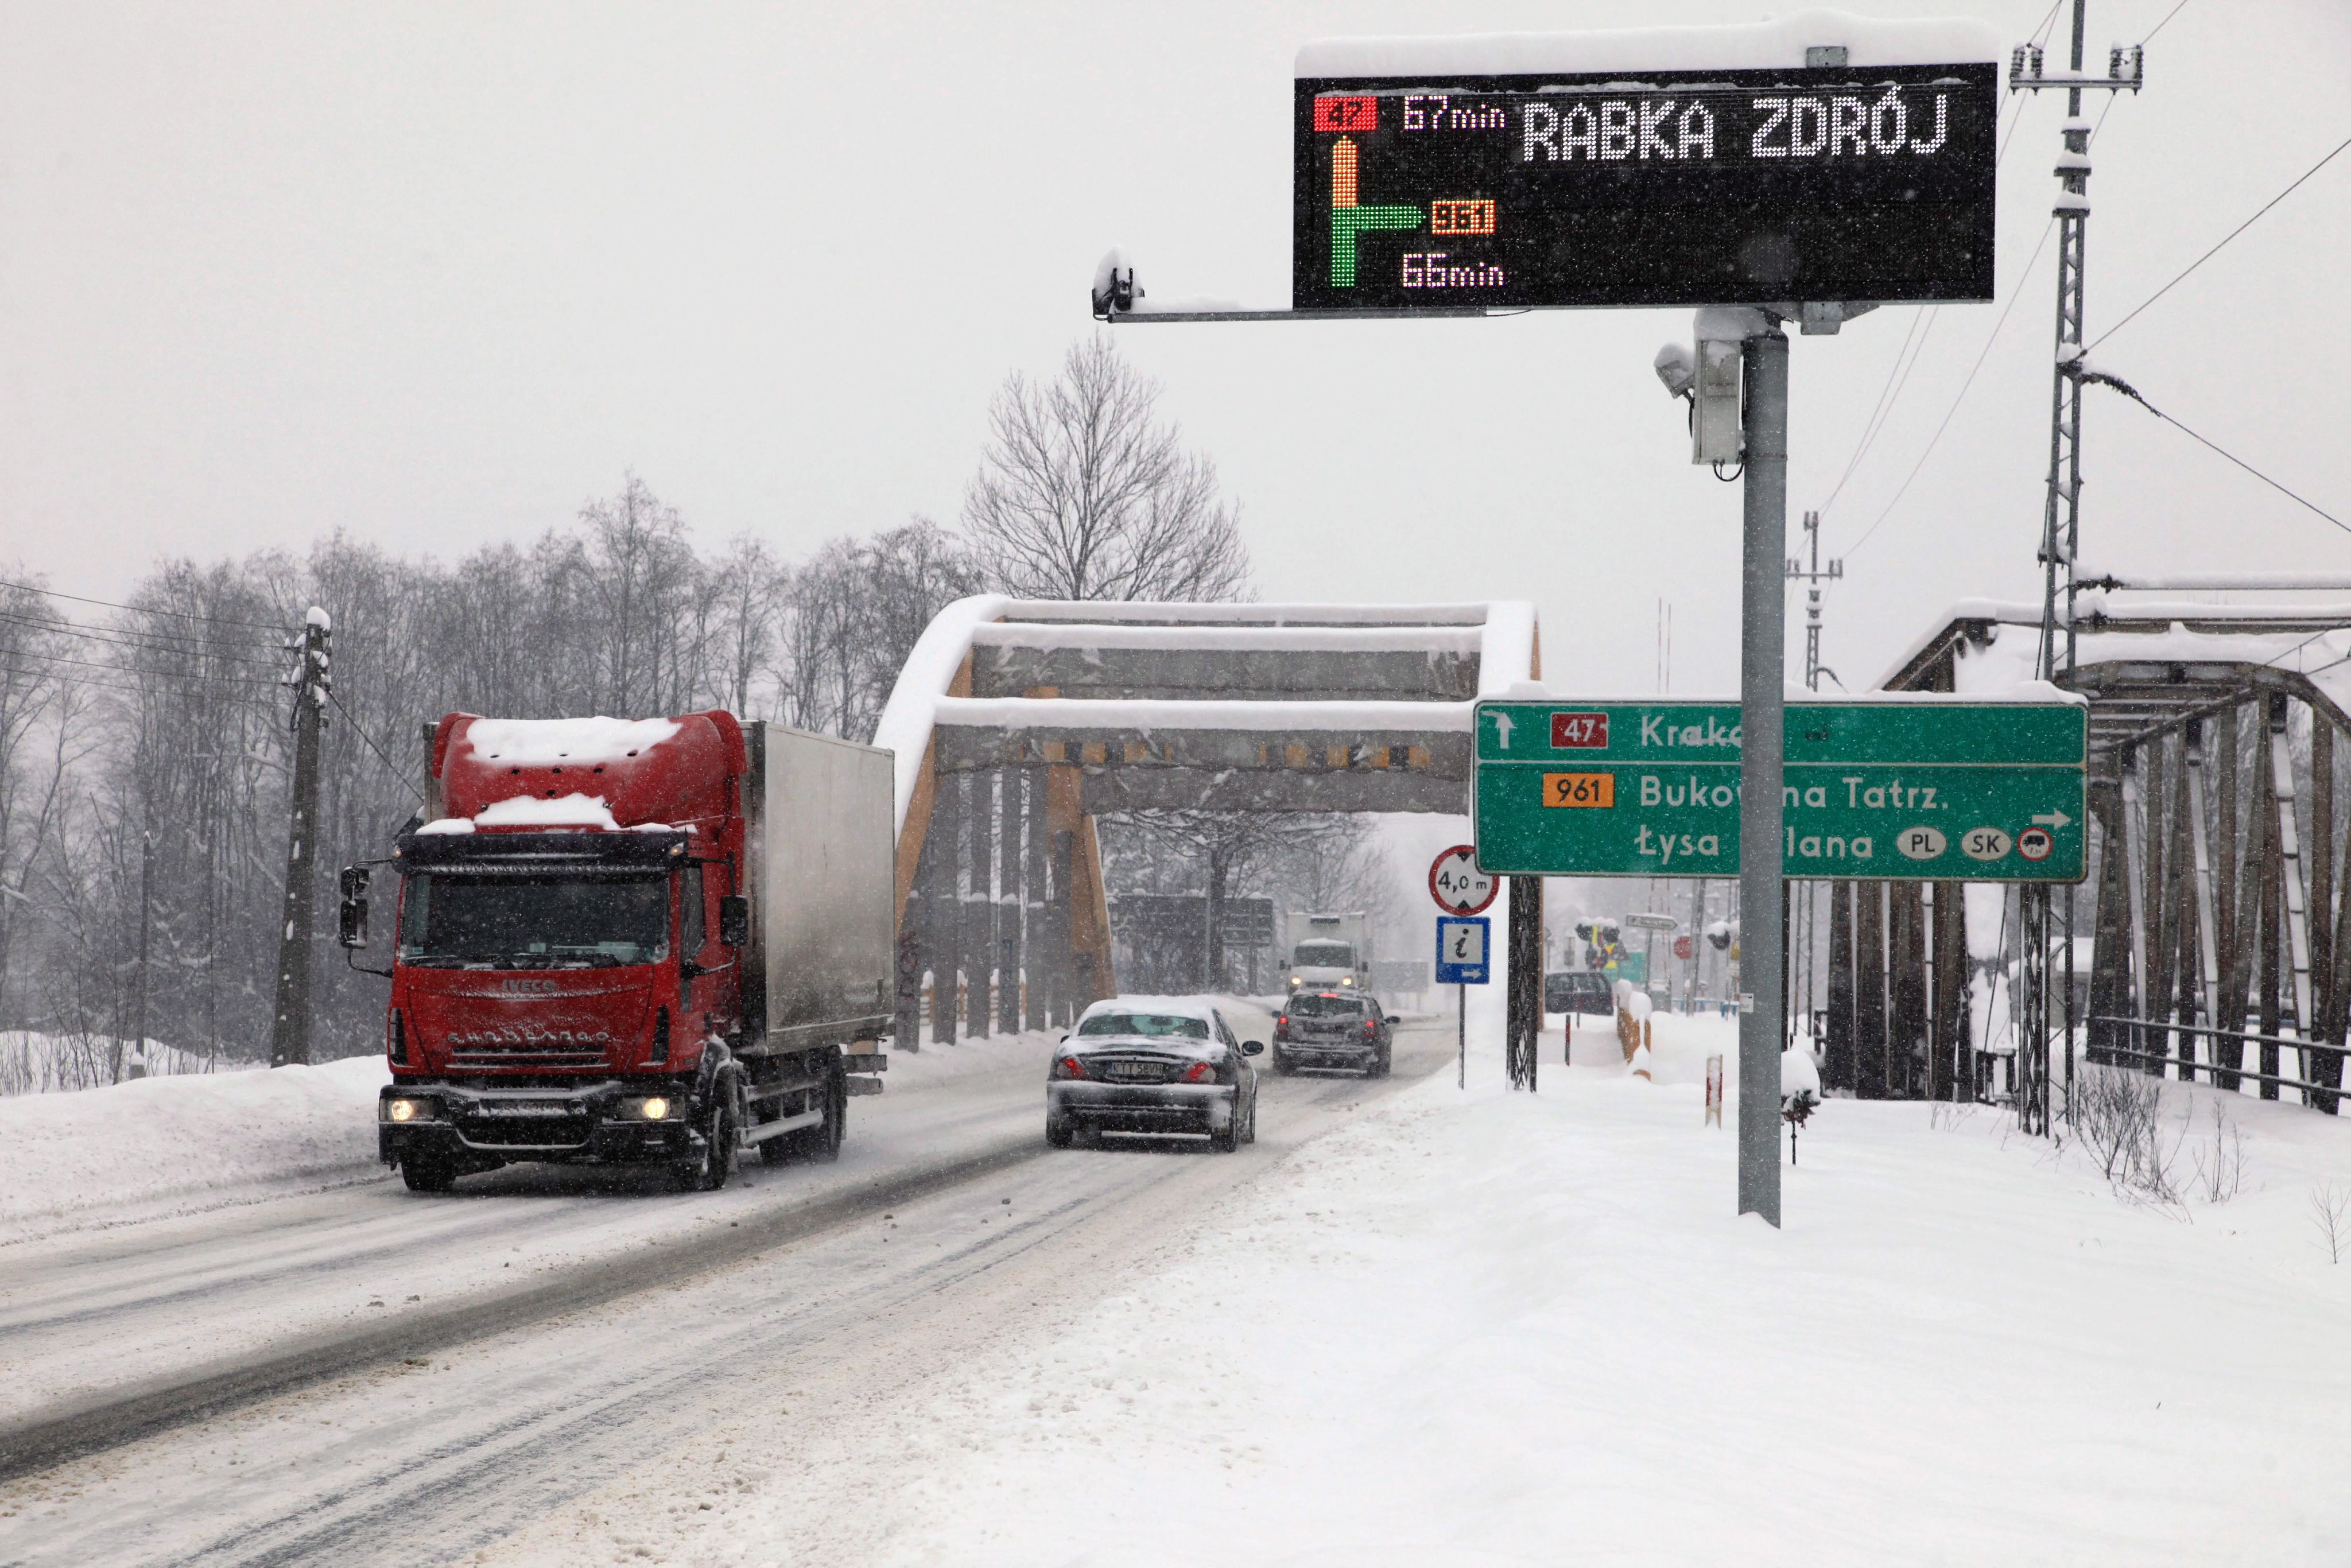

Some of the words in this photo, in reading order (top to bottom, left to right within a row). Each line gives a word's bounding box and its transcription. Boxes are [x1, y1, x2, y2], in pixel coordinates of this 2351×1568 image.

[1325, 99, 1364, 128] 47
[1404, 95, 1506, 130] 67min
[1524, 100, 1713, 161] RABKA
[1752, 86, 1947, 157] ZDRÓJ
[1403, 253, 1505, 288] 66min
[1564, 719, 1596, 742] 47
[1641, 716, 1741, 747] Krako
[1556, 778, 1600, 802] 961
[1640, 775, 1826, 808] Bukona
[1842, 777, 1949, 809] Tatrz.
[1634, 825, 1719, 864] Łysa
[1911, 834, 1935, 852] PL
[1971, 835, 2000, 853] SK
[1438, 871, 1469, 894] 4,0
[1476, 881, 1487, 890] m
[502, 979, 556, 992] IVECO
